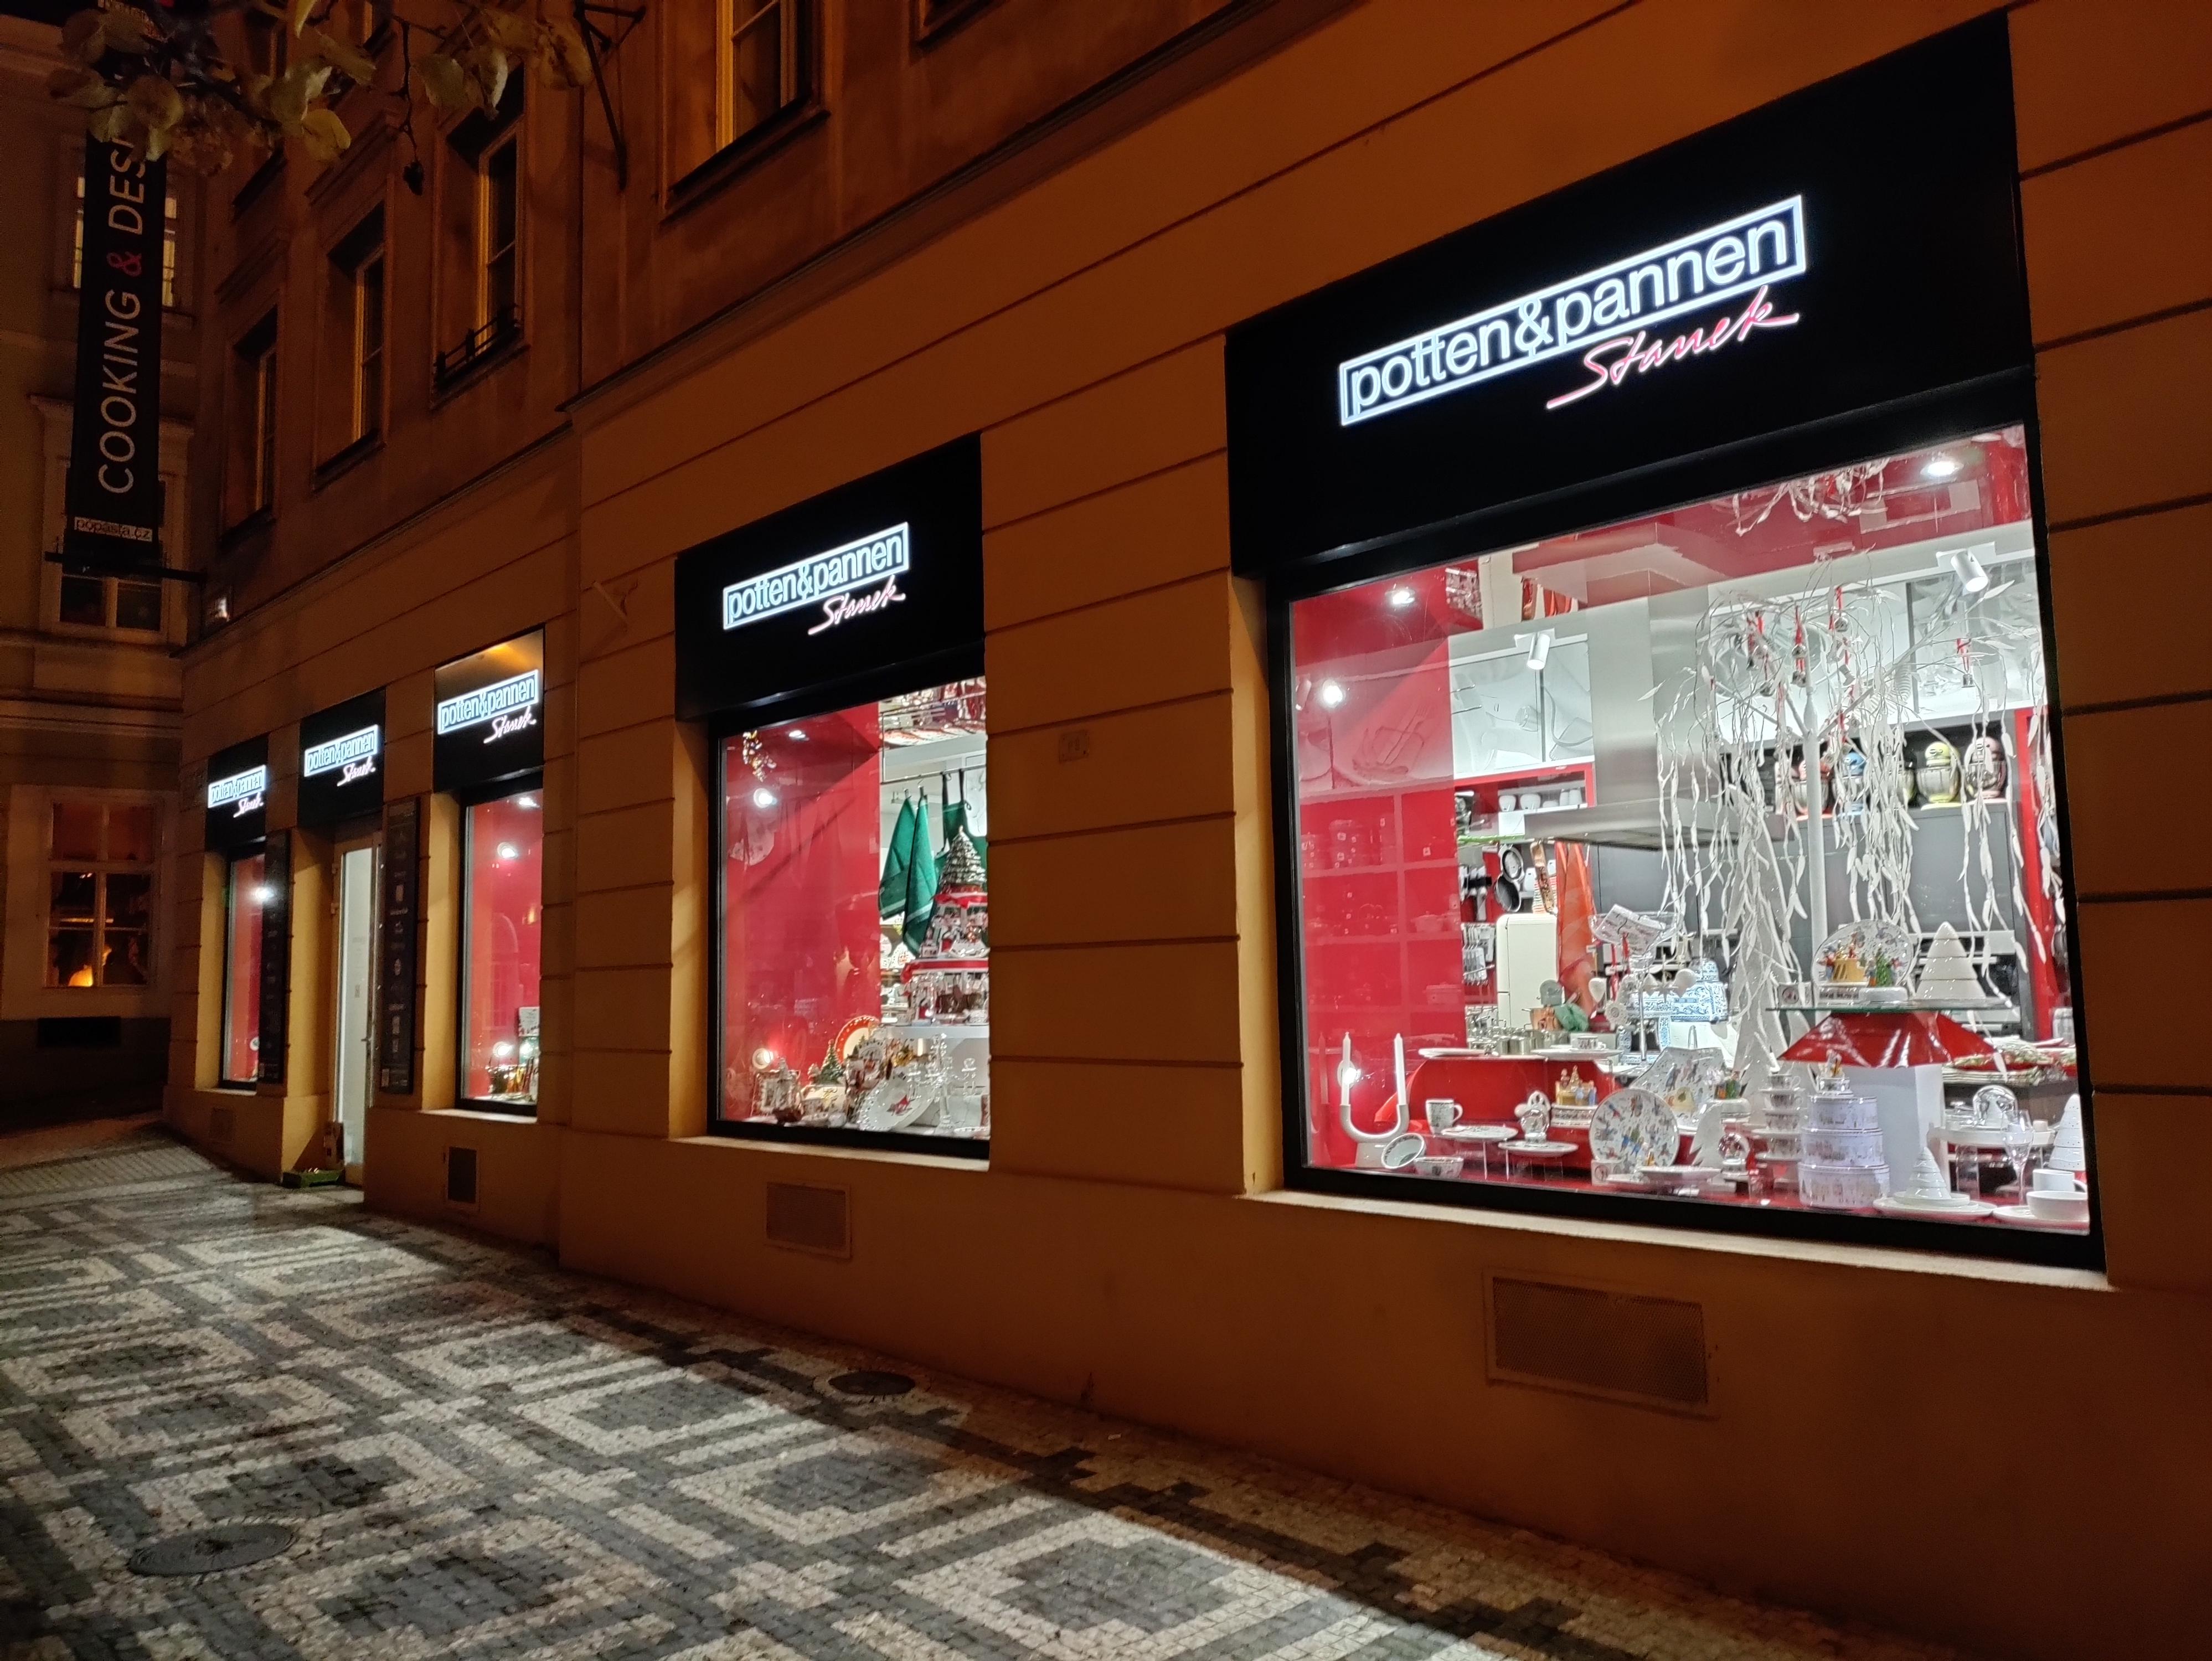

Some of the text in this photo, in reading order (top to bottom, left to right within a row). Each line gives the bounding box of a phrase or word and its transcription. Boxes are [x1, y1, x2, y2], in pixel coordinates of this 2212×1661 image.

[106, 252, 143, 277] &
[1351, 219, 1788, 419] potten&pannen
[98, 289, 141, 494] COOKING
[728, 535, 903, 624] potten&pannen
[441, 678, 535, 728] potten&pannen
